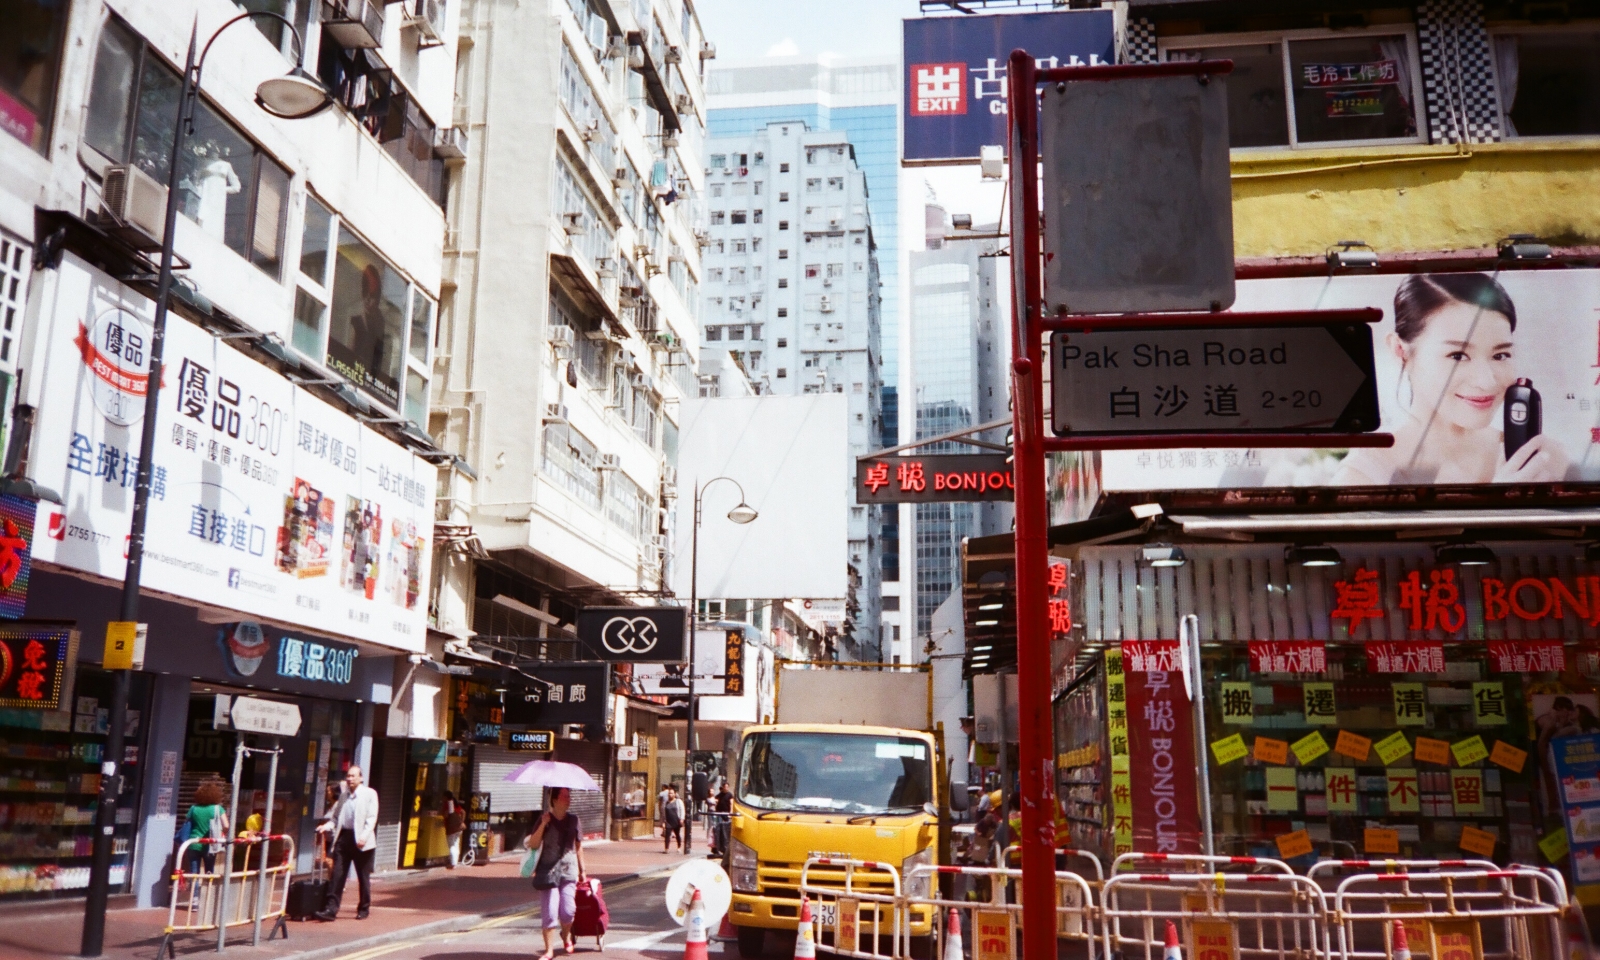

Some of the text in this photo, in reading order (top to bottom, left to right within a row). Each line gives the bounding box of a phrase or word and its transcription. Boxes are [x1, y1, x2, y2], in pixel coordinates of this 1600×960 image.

[917, 98, 959, 112] EXIT
[105, 321, 143, 366] 優品
[1062, 342, 1287, 369] Pak Sha Road
[92, 358, 111, 378] BEST
[326, 353, 364, 386] CLASSICS
[1109, 383, 1241, 419] 白沙道
[935, 471, 1014, 492] BONJOU
[68, 525, 89, 541] 2755
[188, 503, 265, 557] 直接進口
[1123, 642, 1153, 659] SALE
[1250, 642, 1282, 658] SALE
[1367, 642, 1399, 658] SALE
[1490, 642, 1521, 658] SALE
[512, 734, 548, 743] CHANGE
[1151, 738, 1178, 852] BONJOUR
